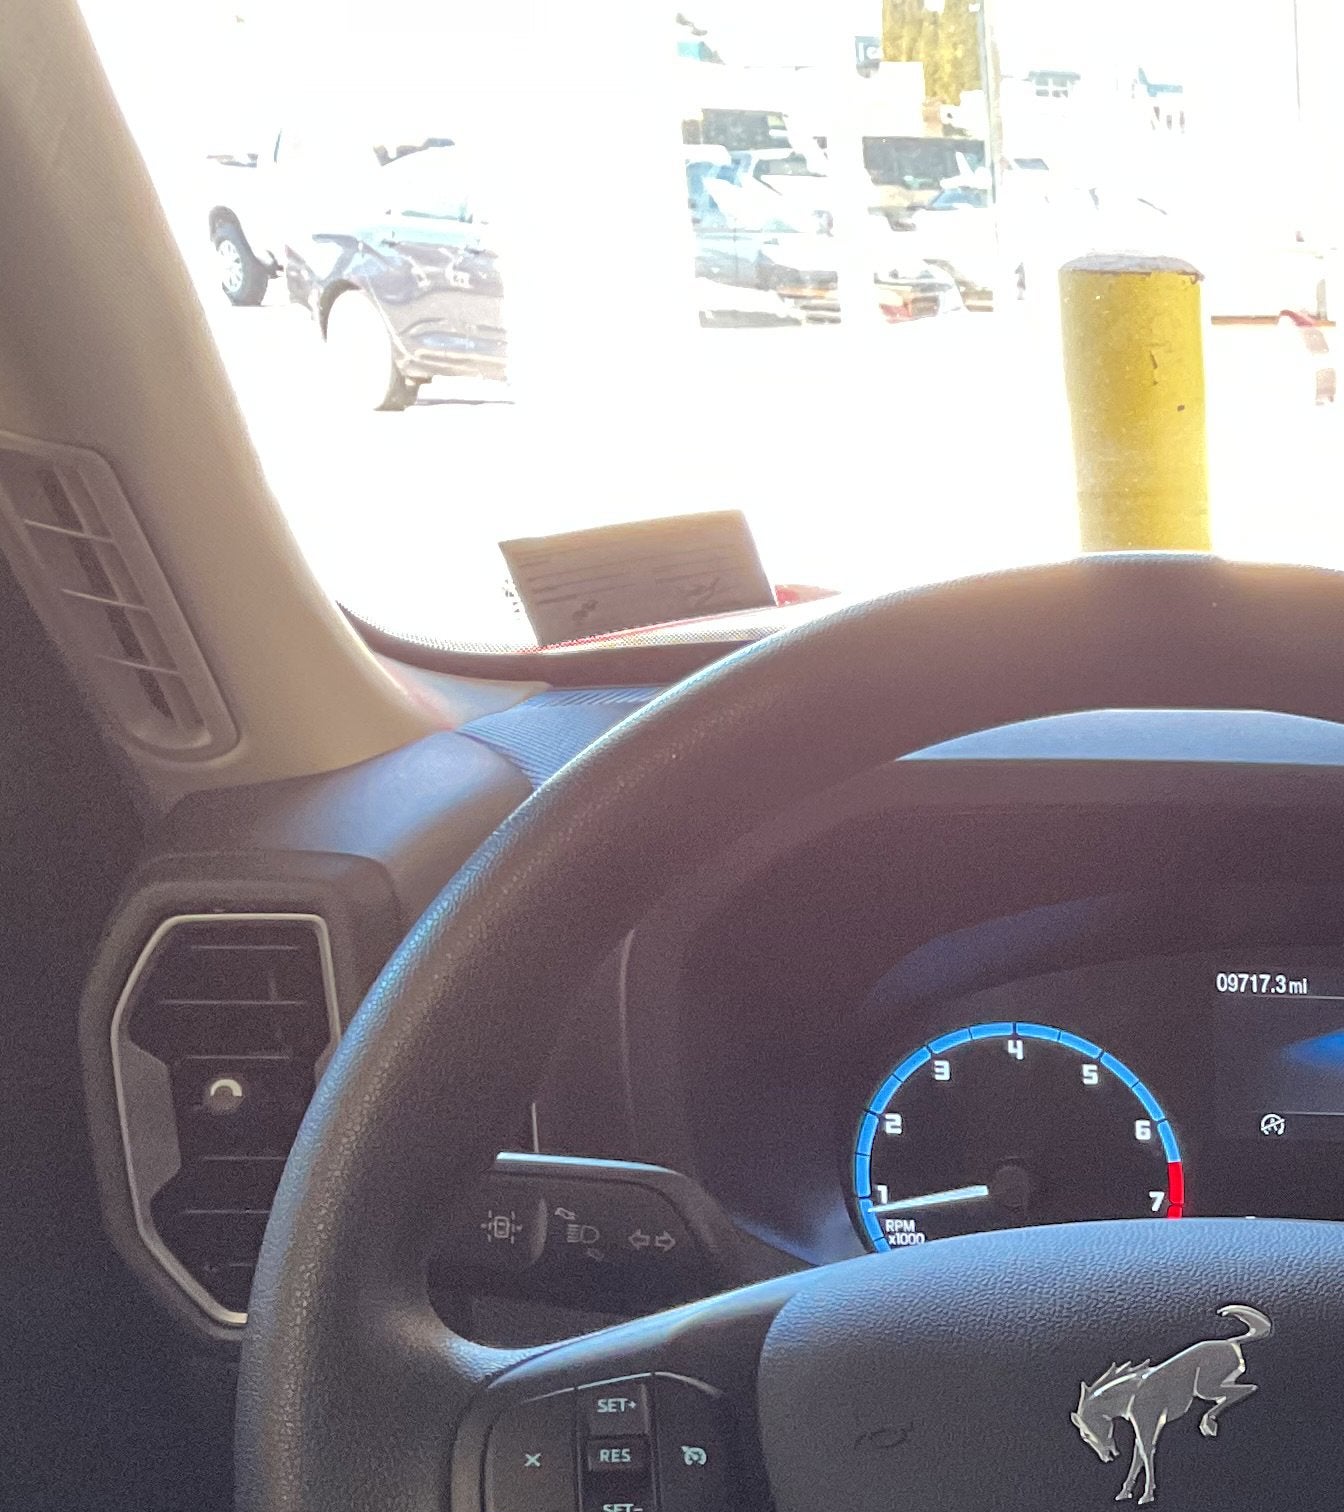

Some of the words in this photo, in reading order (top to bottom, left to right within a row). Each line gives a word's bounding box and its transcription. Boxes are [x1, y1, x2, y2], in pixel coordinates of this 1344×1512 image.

[1217, 972, 1286, 993] 09717.3
[1289, 977, 1307, 993] mi
[1008, 1040, 1023, 1059] 4
[934, 1061, 951, 1080] 3
[1082, 1064, 1098, 1084] 5
[882, 1110, 903, 1135] 2
[1135, 1117, 1153, 1140] 6
[876, 1184, 888, 1204] 1
[1149, 1192, 1164, 1211] 7
[885, 1220, 915, 1233] RPM
[888, 1232, 925, 1245] x1000
[600, 1448, 631, 1462] RES
